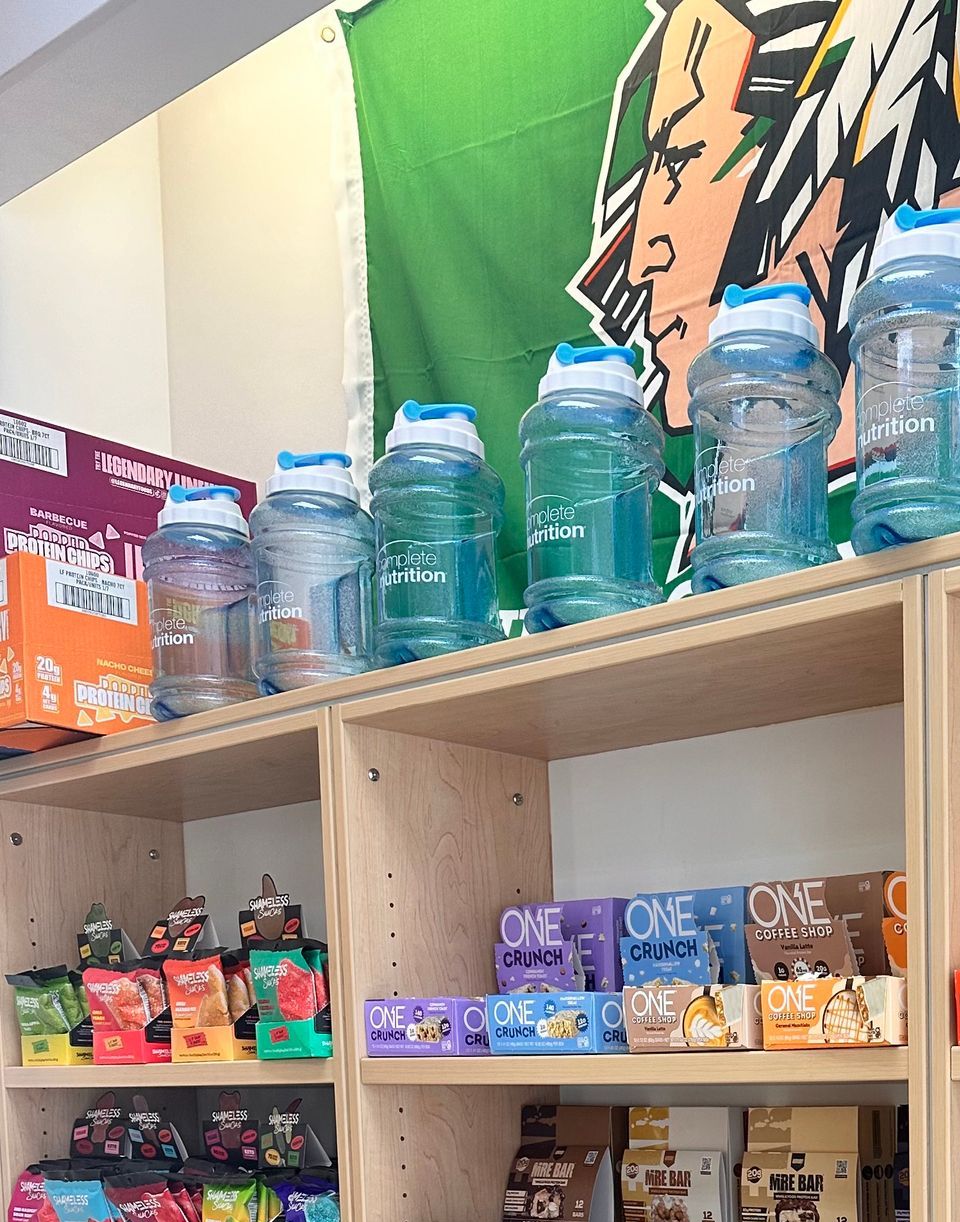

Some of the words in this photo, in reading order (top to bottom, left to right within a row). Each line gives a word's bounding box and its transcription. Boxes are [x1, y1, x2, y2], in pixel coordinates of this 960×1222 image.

[30, 508, 87, 529] BARBECUE
[67, 549, 110, 571] CHIPS
[36, 656, 60, 674] 20g
[97, 658, 126, 670] NACHO
[250, 895, 289, 911] SHAMELESS
[750, 881, 830, 928] ONE
[501, 907, 563, 948] ONE
[626, 896, 697, 939] ONE
[755, 928, 798, 941] COFFEE
[801, 926, 833, 938] SHOP
[503, 948, 563, 968] CRUNCH
[630, 939, 698, 962] CRUNCH
[631, 990, 677, 1016] ONE
[767, 985, 816, 1012] ONE
[370, 1006, 406, 1029] ONE
[494, 1000, 535, 1025] ONE
[371, 1030, 406, 1041] CRUNCH
[495, 1027, 536, 1039] CRUNCH
[769, 1174, 796, 1191] MRE
[798, 1175, 824, 1192] BAR
